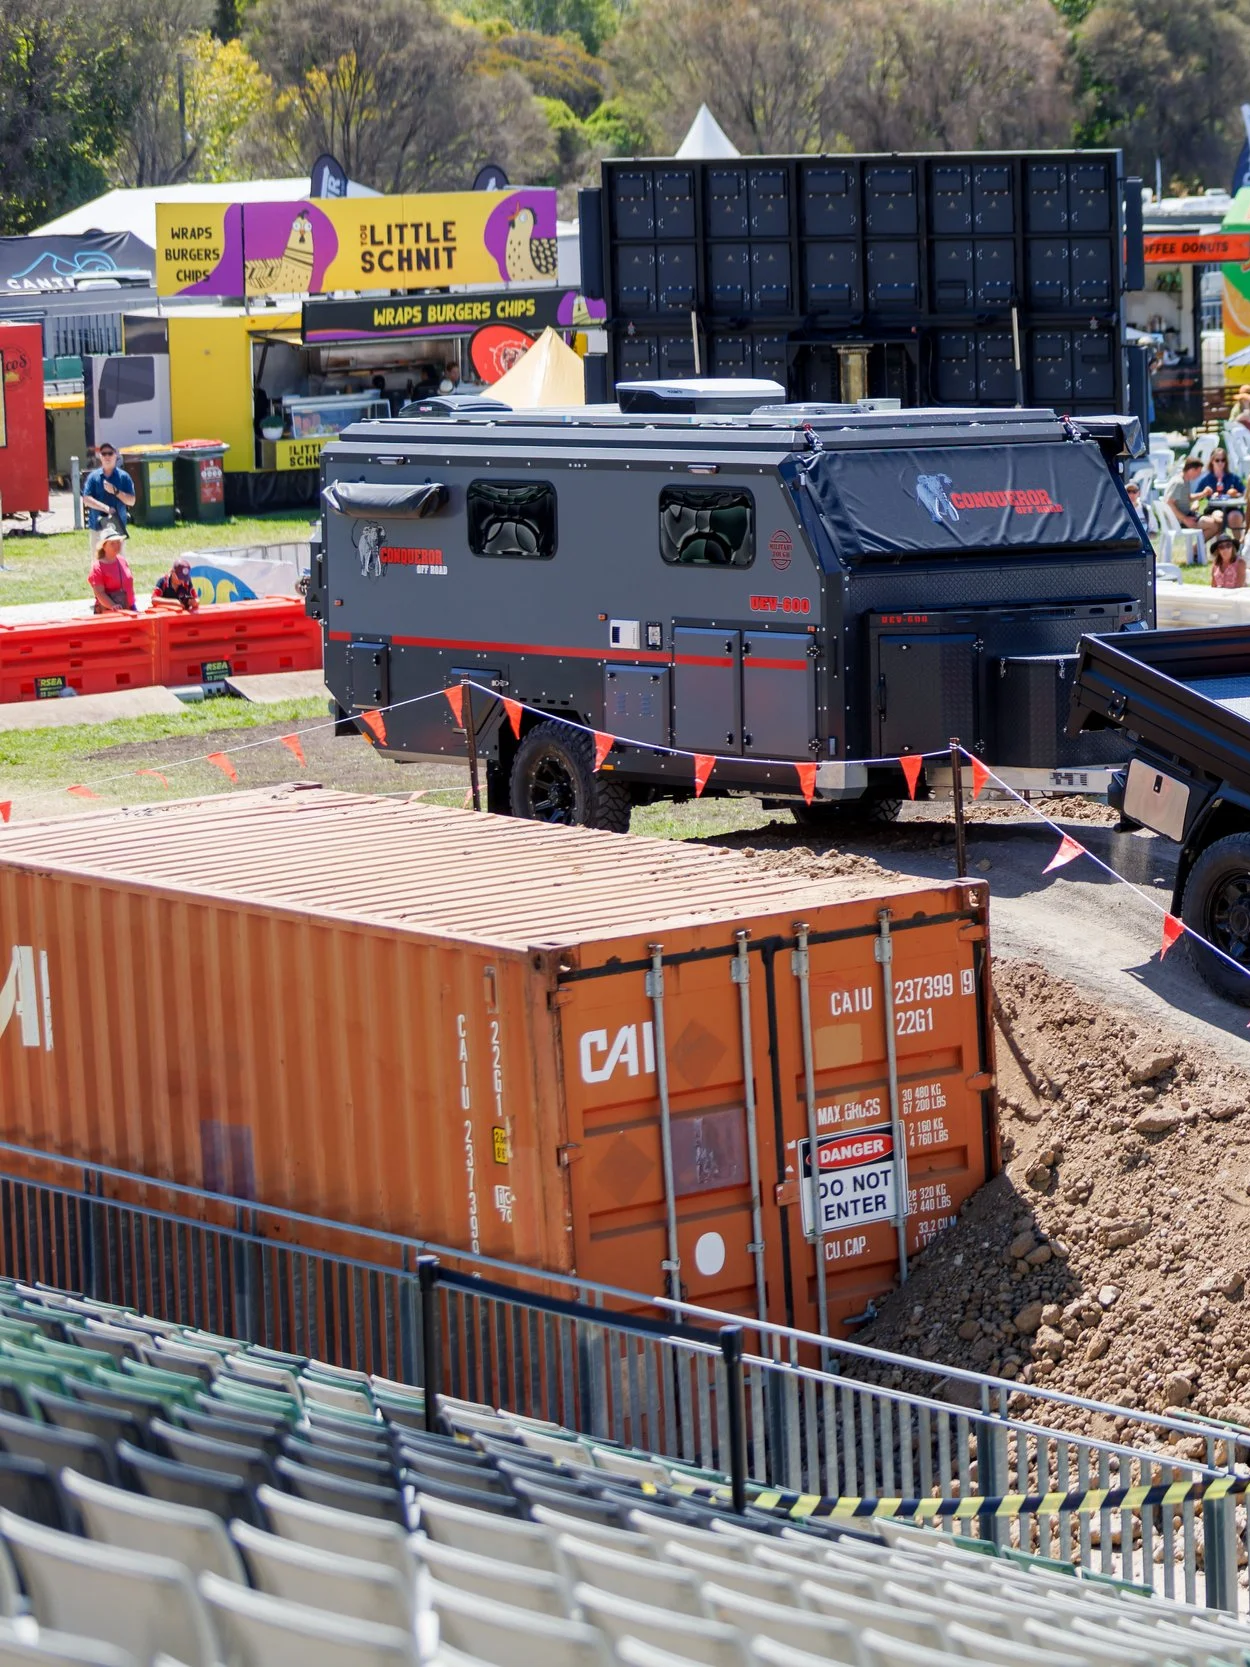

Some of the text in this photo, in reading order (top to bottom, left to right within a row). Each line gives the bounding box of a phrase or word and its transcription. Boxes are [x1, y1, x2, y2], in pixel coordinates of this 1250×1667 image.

[171, 226, 212, 240] WRAPS
[370, 221, 456, 246] LITTLE
[165, 248, 220, 261] BURGERS
[1143, 242, 1228, 254] OFFEE DONUTS
[361, 246, 457, 273] SCHNIT
[176, 269, 210, 282] CHIPS
[373, 299, 535, 326] WRAPS BURGERS CHIPS
[294, 444, 321, 455] LITT
[290, 455, 320, 467] SCHN
[950, 489, 1053, 510] CONQUEROR
[380, 547, 443, 566] CONQUEROR
[416, 564, 448, 575] OFF ROAD
[750, 595, 811, 614] UEV-600
[881, 615, 928, 624] UEV-600
[0, 945, 54, 1052] AI
[831, 969, 974, 1016] CAIU 237399 9
[896, 1007, 933, 1035] 22G1
[457, 1013, 470, 1109] CAIU
[580, 1021, 656, 1084] CAI
[490, 1021, 503, 1117] 22G1
[902, 1083, 942, 1101] 30 480 KG
[903, 1095, 947, 1115] 67 200 LBS
[909, 1117, 944, 1135] 2 160 KG
[909, 1130, 949, 1148] 4 760 LBS
[820, 1138, 884, 1164] DANGER
[820, 1169, 892, 1200] DO NOT
[920, 1187, 934, 1200] 320
[935, 1183, 947, 1196] KG
[824, 1194, 887, 1222] ENTER
[908, 1195, 951, 1215] 62 440 LBS
[919, 1221, 936, 1234] 33.2
[938, 1218, 948, 1230] CU
